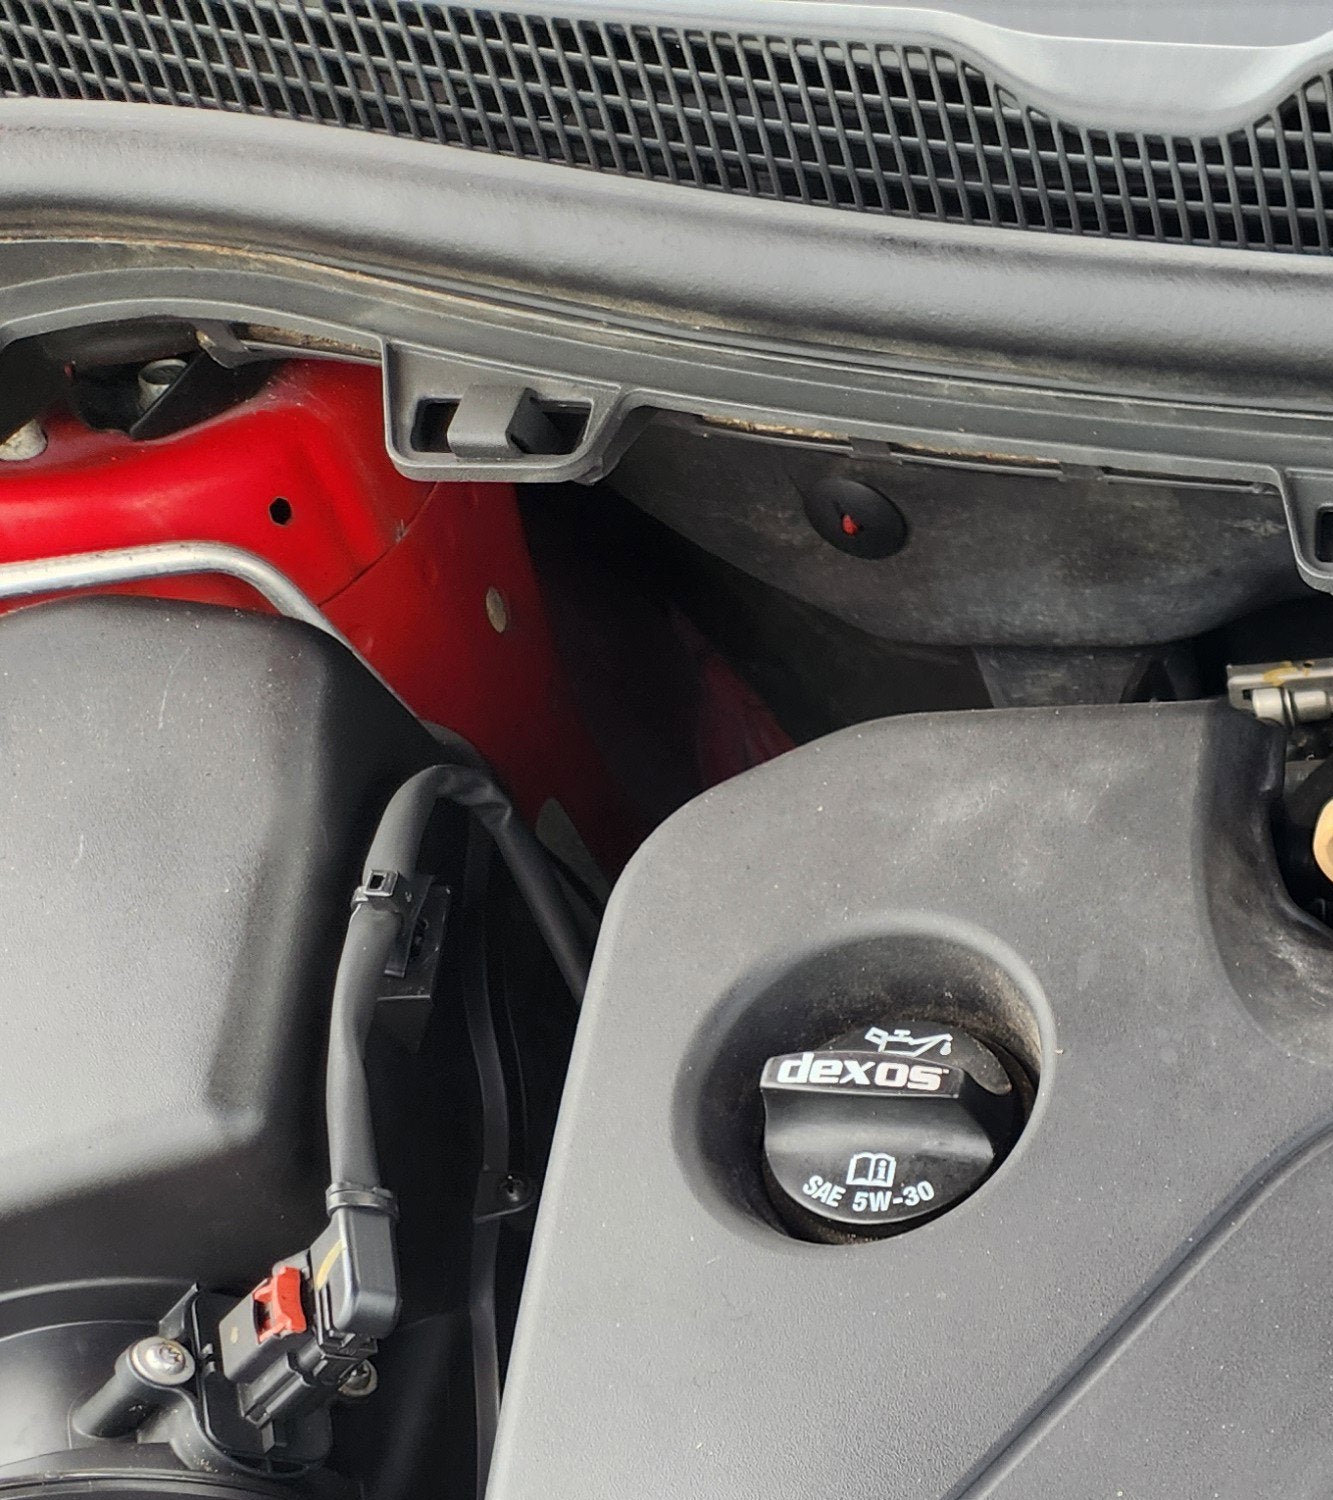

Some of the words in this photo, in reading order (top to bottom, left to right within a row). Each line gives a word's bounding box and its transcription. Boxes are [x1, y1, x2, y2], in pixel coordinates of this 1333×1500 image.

[776, 1052, 943, 1091] dexos
[802, 1174, 846, 1208] SAE
[852, 1180, 935, 1212] 5W-30
